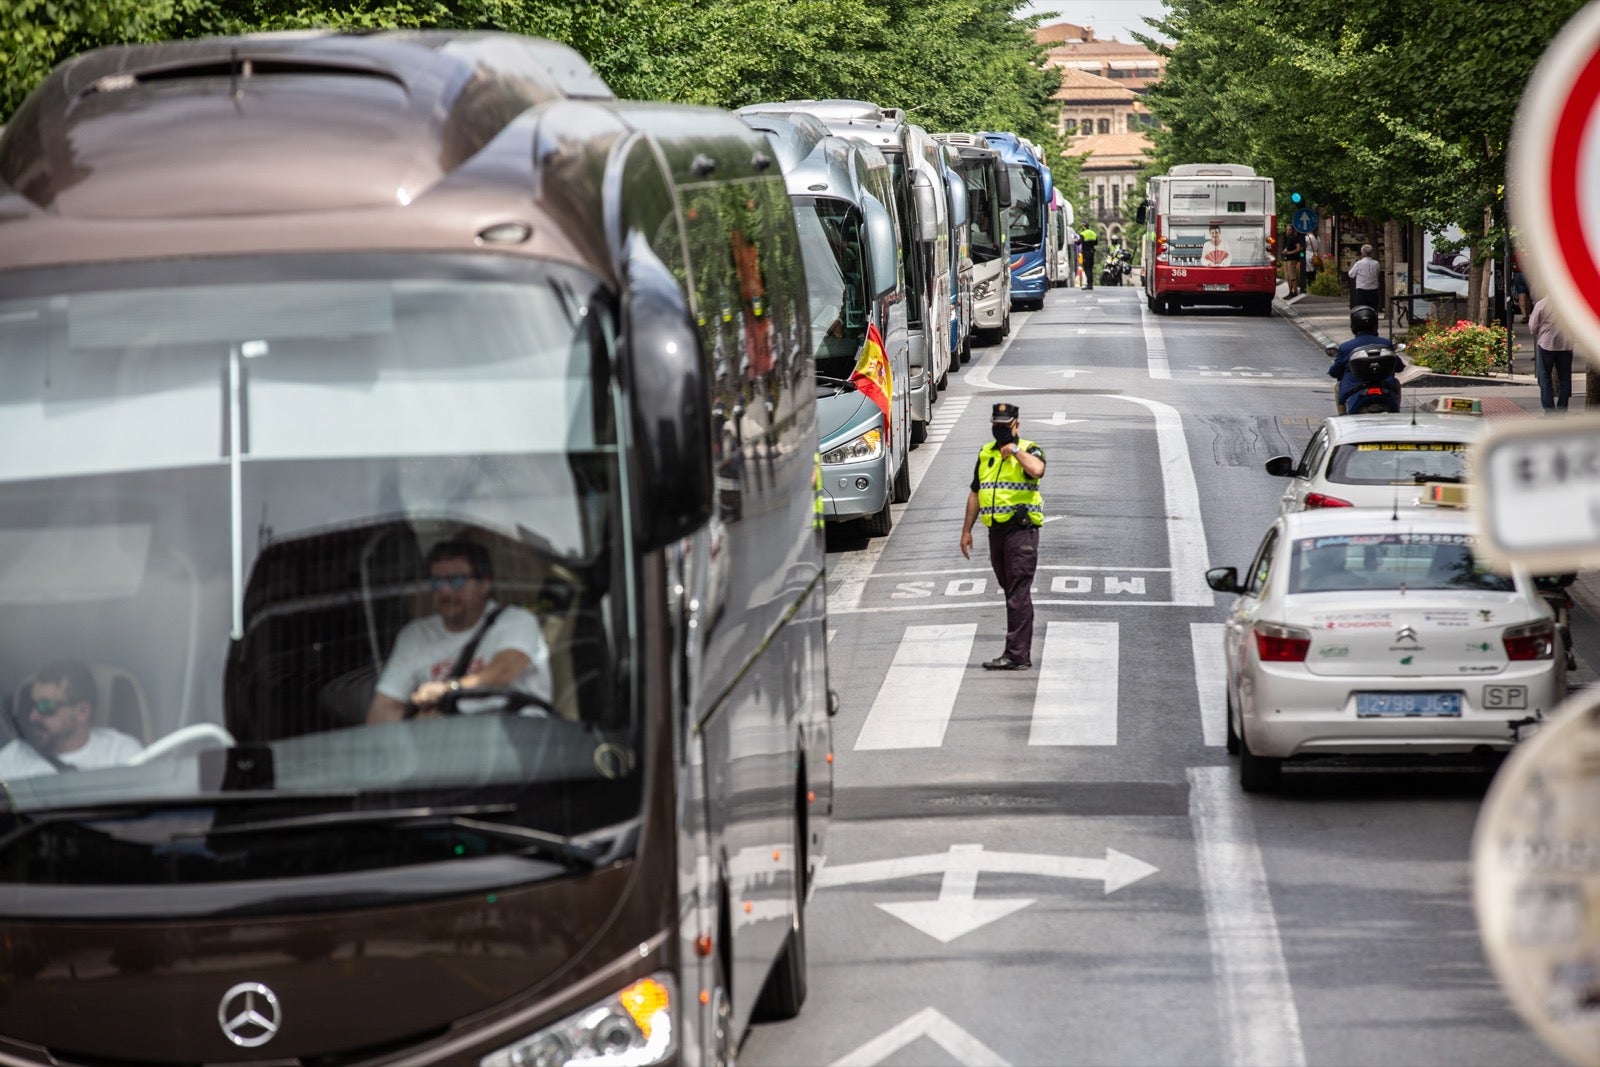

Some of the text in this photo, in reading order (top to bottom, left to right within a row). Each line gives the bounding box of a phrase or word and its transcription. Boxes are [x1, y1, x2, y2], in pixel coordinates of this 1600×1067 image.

[1171, 268, 1188, 277] 368
[890, 576, 1147, 599] MOOS
[1489, 688, 1521, 705] SP
